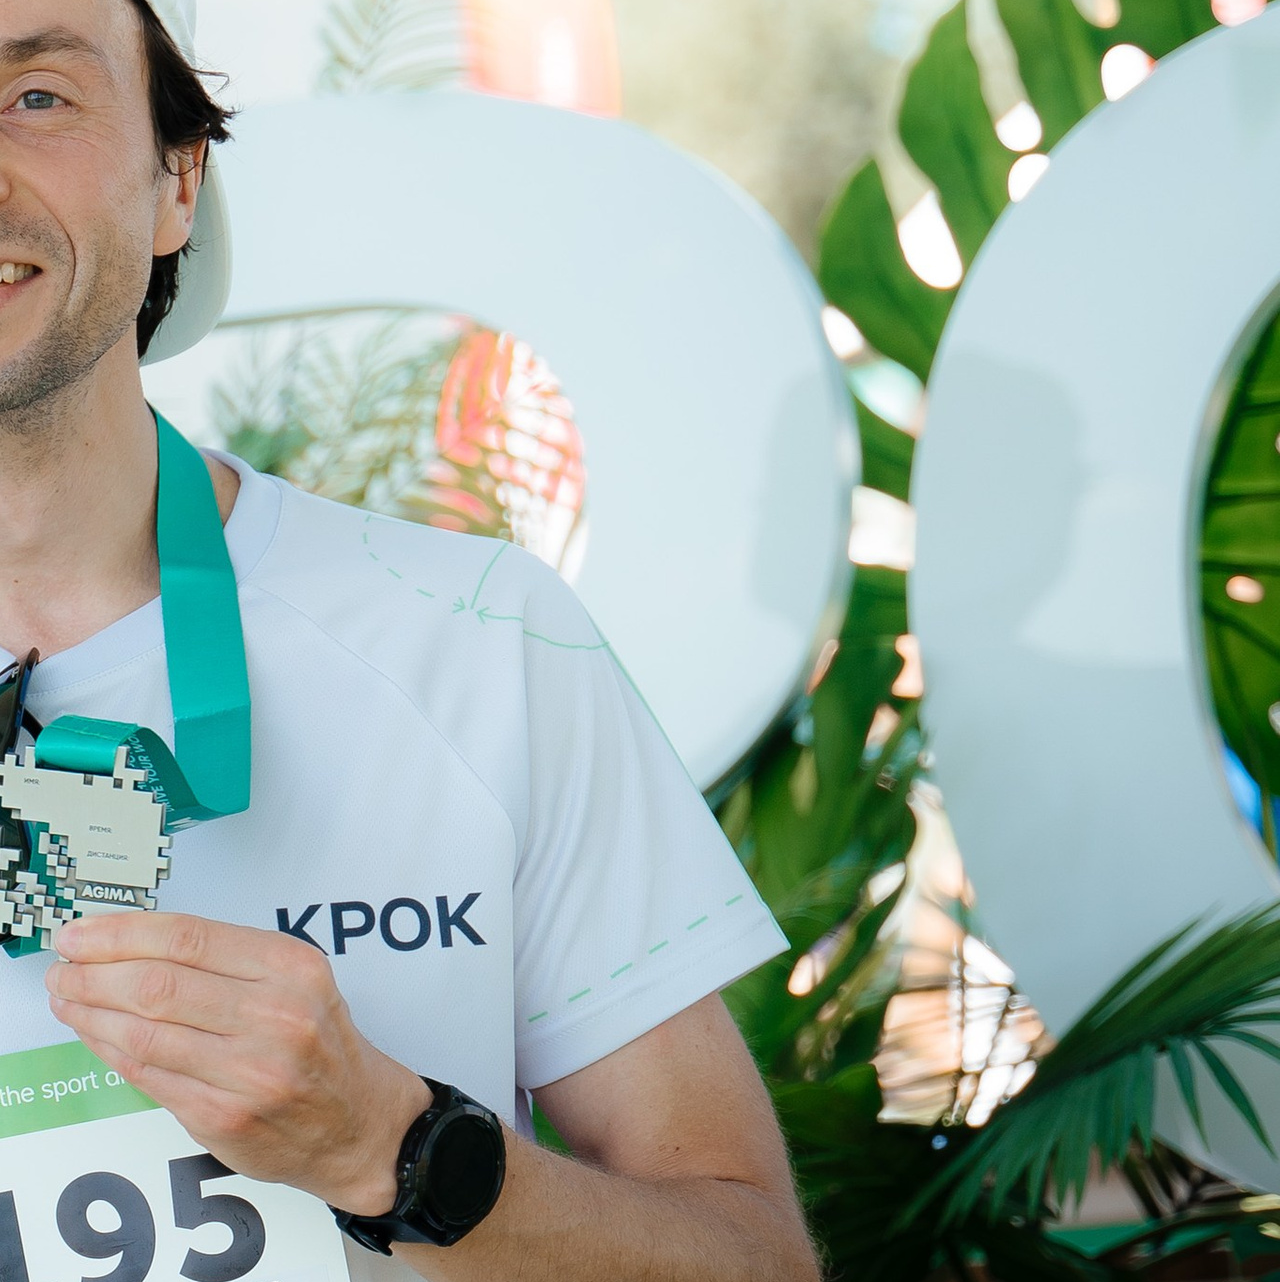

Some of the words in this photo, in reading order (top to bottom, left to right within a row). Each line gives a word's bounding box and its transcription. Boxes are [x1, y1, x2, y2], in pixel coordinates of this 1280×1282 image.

[128, 732, 146, 754] WO
[81, 884, 136, 904] AGIMA
[275, 891, 488, 956] КРОК
[41, 1070, 99, 1103] sport
[104, 1070, 126, 1087] a
